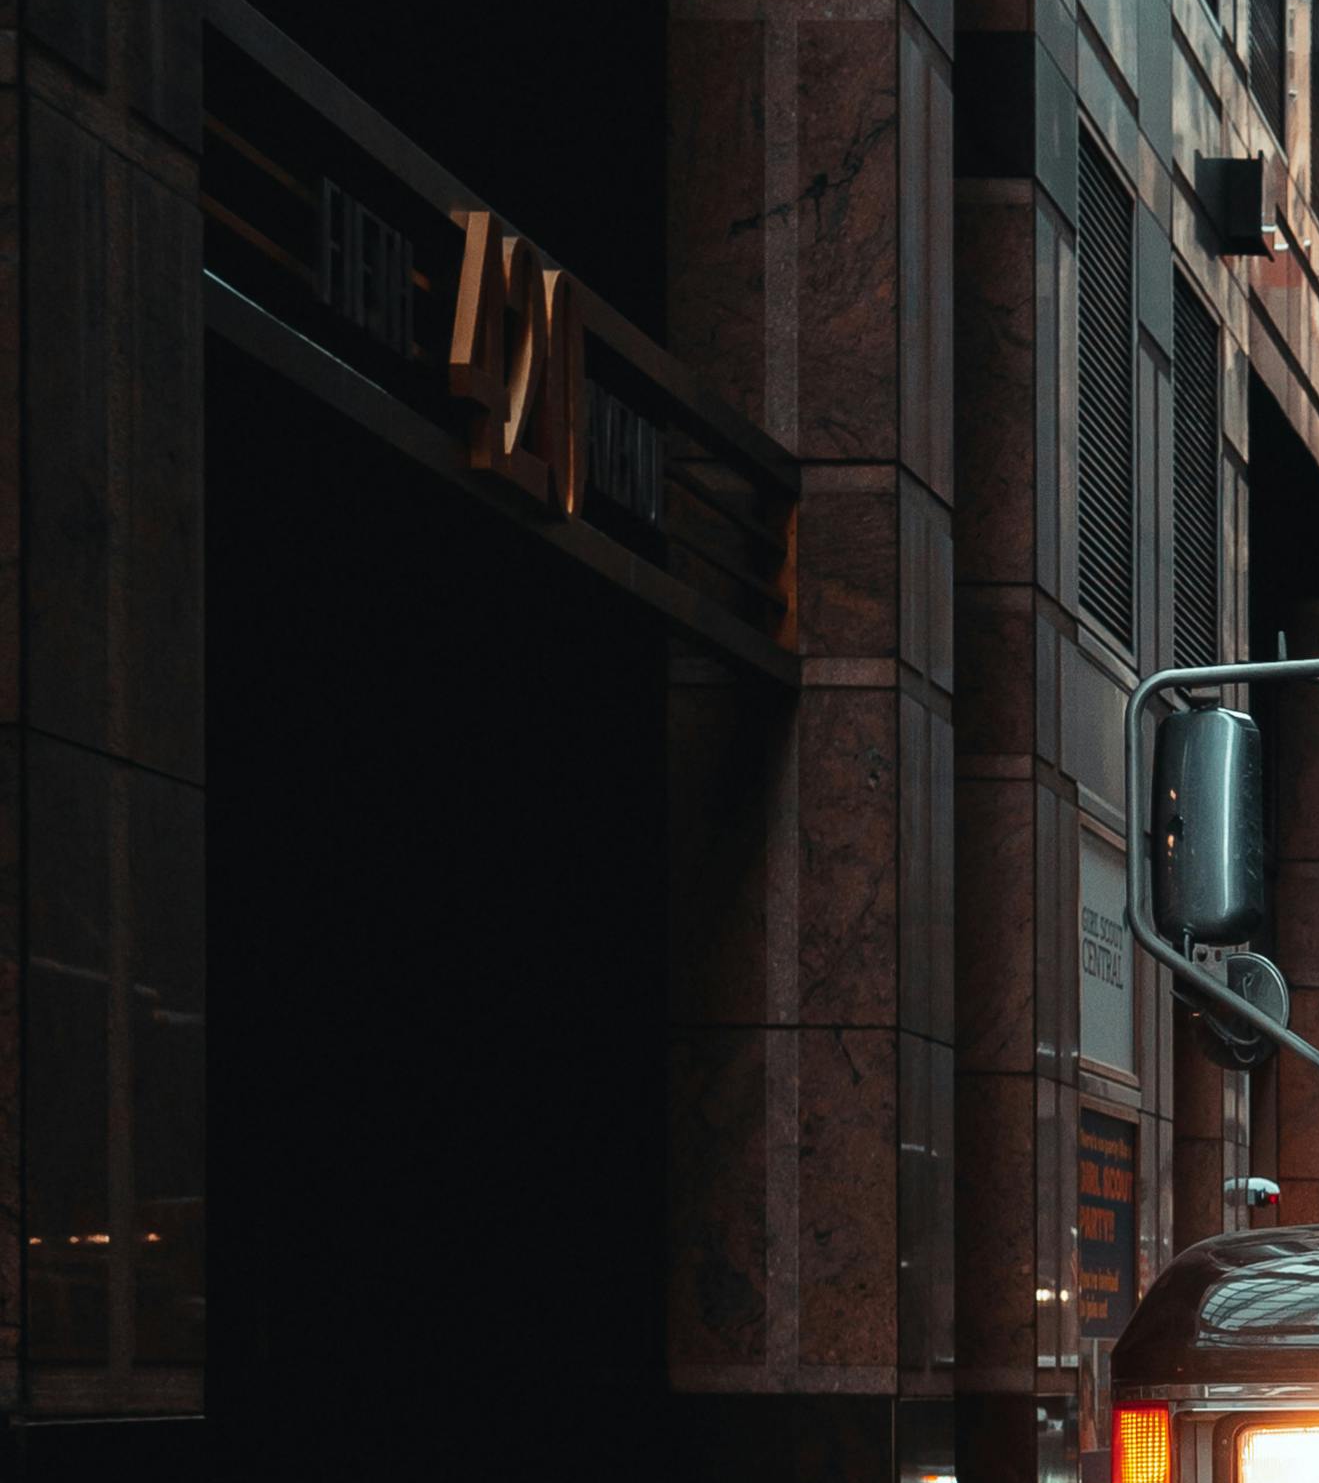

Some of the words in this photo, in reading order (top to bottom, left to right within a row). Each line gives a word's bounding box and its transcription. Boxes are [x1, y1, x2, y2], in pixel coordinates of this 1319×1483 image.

[449, 210, 586, 517] 420
[1100, 916, 1123, 951] SCOUT
[1082, 938, 1124, 990] CENTRAL
